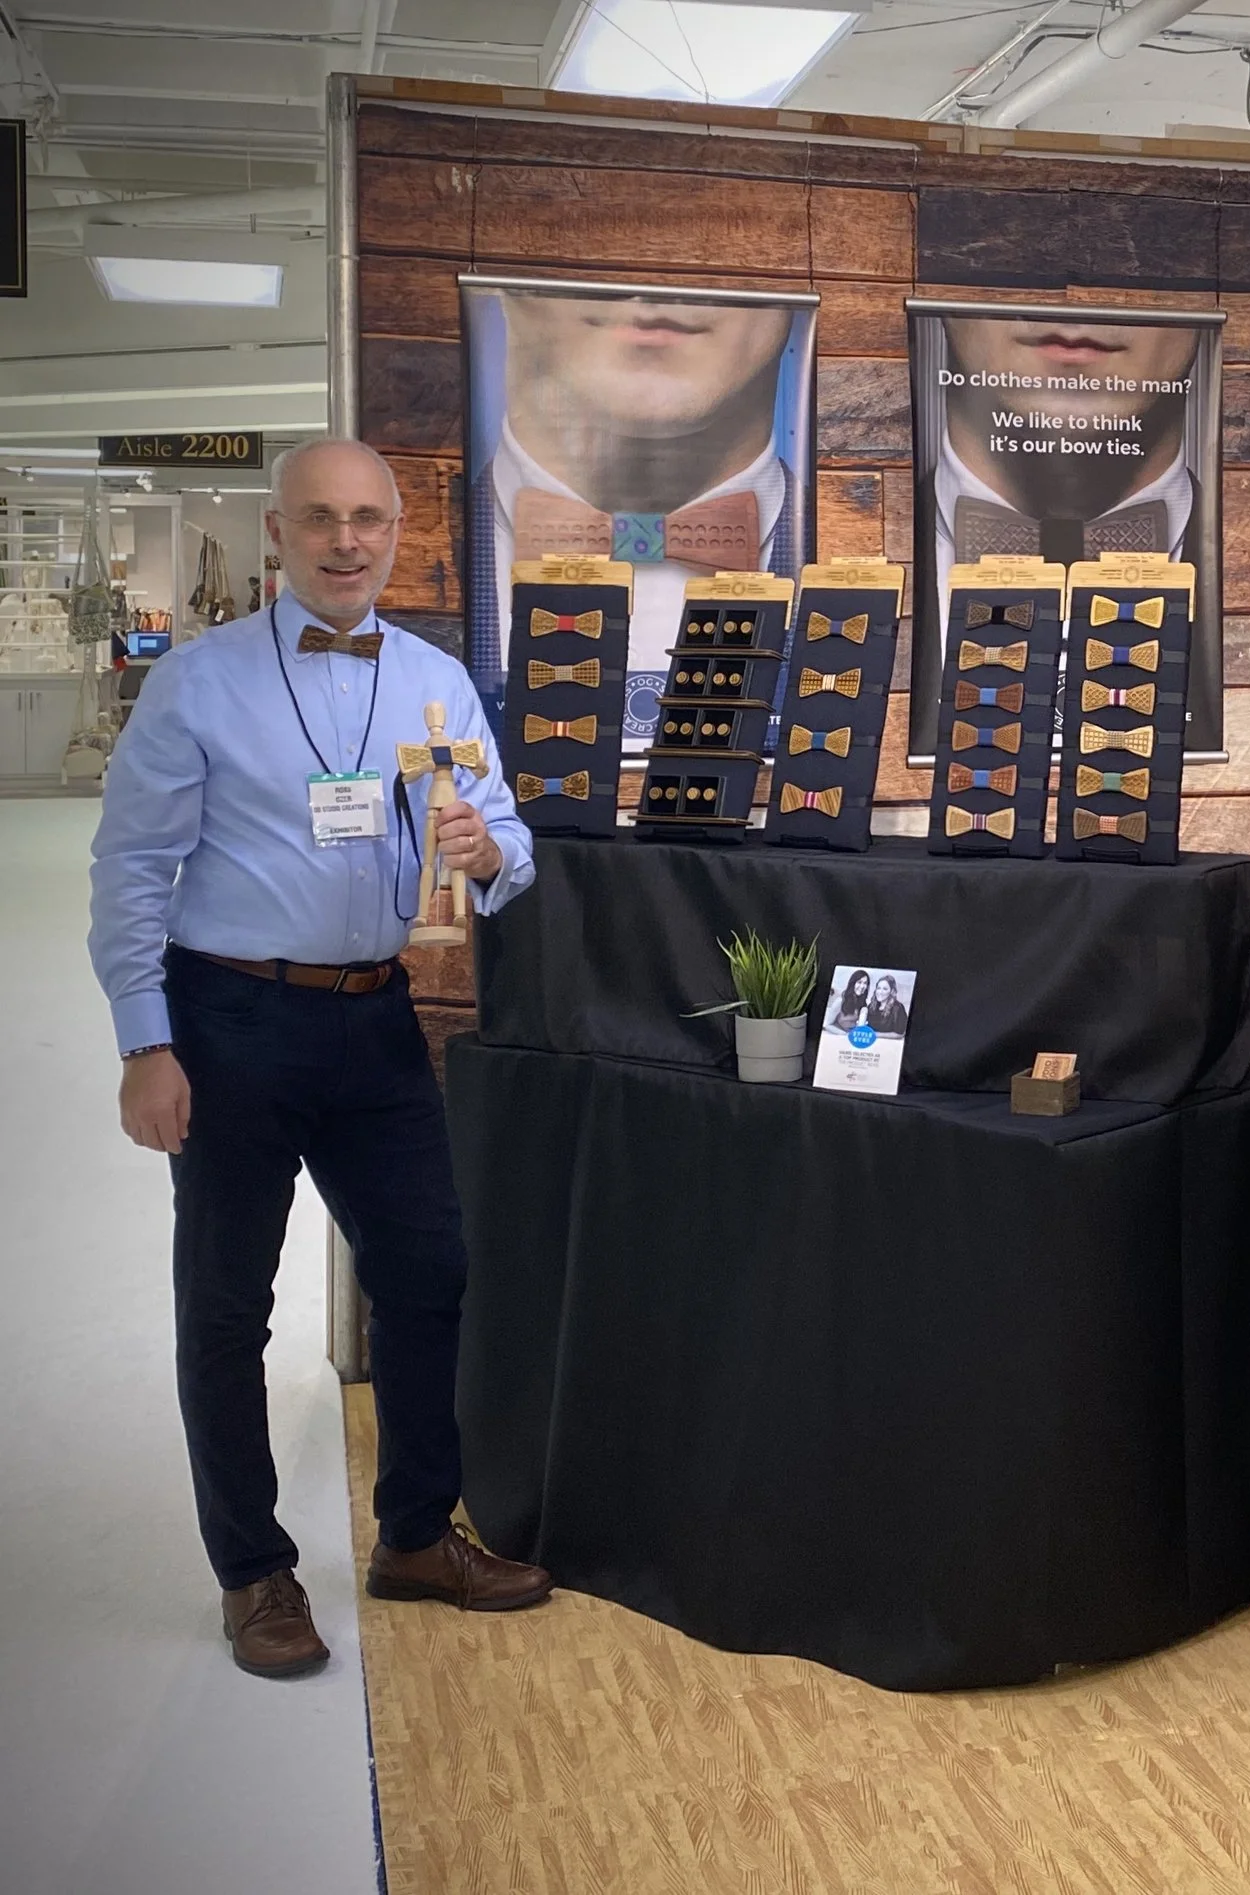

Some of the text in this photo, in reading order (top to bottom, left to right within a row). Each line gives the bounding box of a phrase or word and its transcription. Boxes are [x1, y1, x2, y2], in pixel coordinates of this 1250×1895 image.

[938, 369, 1193, 394] Do clothes make the man?
[991, 411, 1143, 432] We like to think
[117, 434, 249, 459] Aisle 2200
[990, 434, 1145, 456] it's our bow ties.
